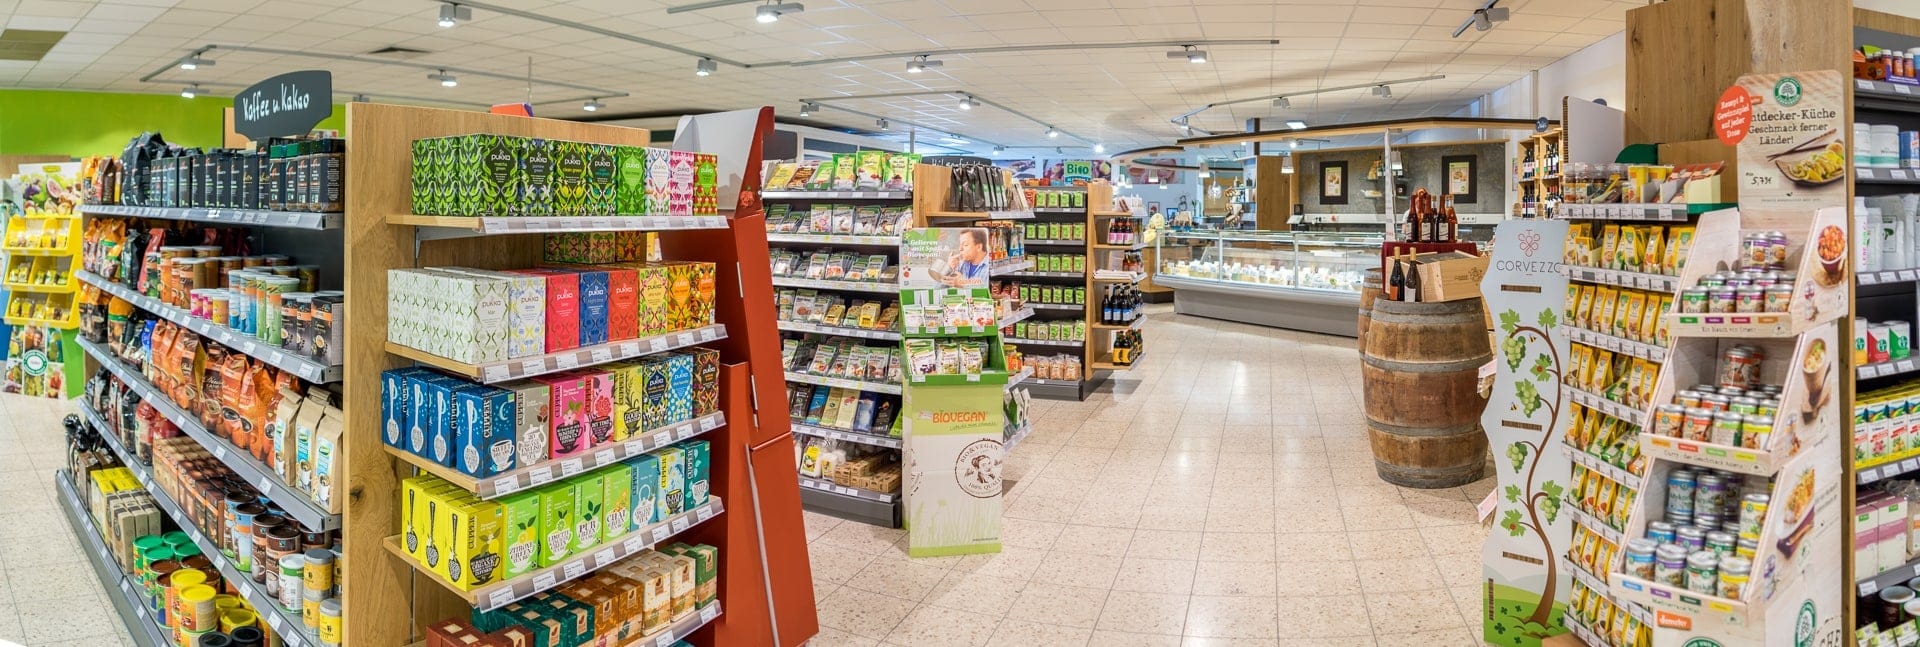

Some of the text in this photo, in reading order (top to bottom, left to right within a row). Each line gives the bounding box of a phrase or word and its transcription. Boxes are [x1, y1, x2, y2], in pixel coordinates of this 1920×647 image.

[242, 83, 310, 122] Kaffee u Kakao
[1717, 103, 1750, 120] Gewinnspiel
[1751, 108, 1837, 122] ntdecker-Küche
[1721, 120, 1731, 129] auf
[1748, 122, 1829, 134] Geschmack ferner
[1727, 130, 1741, 138] Dose
[1759, 135, 1794, 145] Länder!
[910, 239, 938, 247] Gelieren
[556, 292, 573, 300] pukka
[588, 289, 604, 297] pukka
[579, 520, 596, 533] PUR
[1658, 614, 1688, 627] demeter
